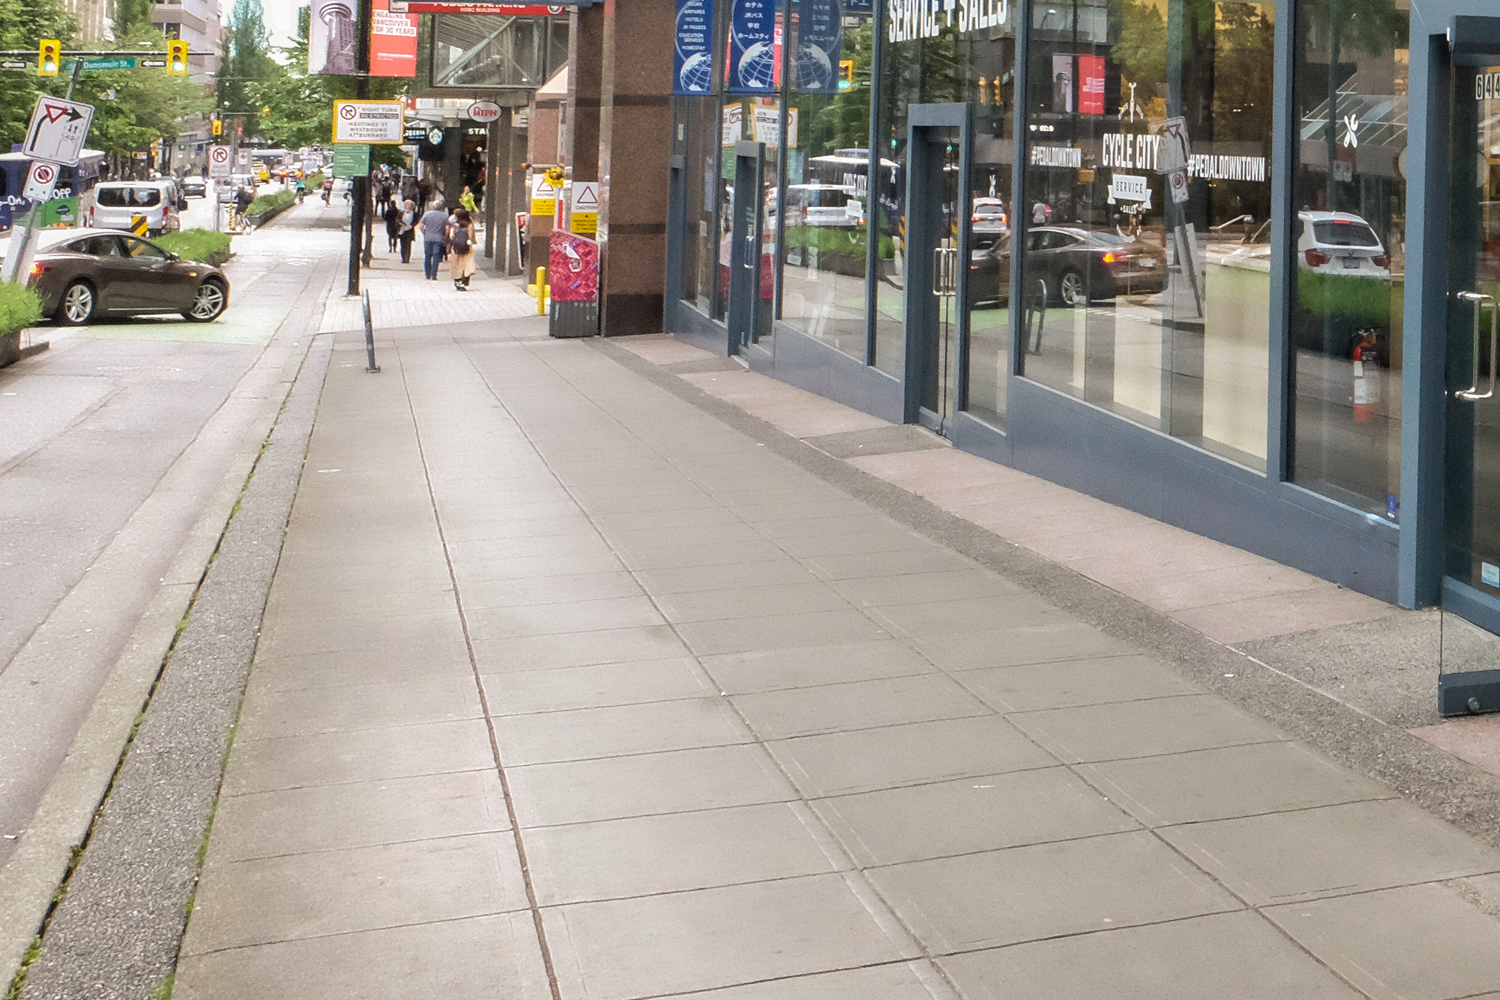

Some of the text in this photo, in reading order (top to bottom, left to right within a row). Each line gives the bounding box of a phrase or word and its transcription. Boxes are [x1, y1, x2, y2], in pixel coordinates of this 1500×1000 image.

[1476, 73, 1500, 99] 644
[1102, 132, 1160, 170] CYCLE CITY
[1188, 153, 1265, 182] #PEDALDOWNTOWN
[1115, 181, 1143, 194] SERVICE
